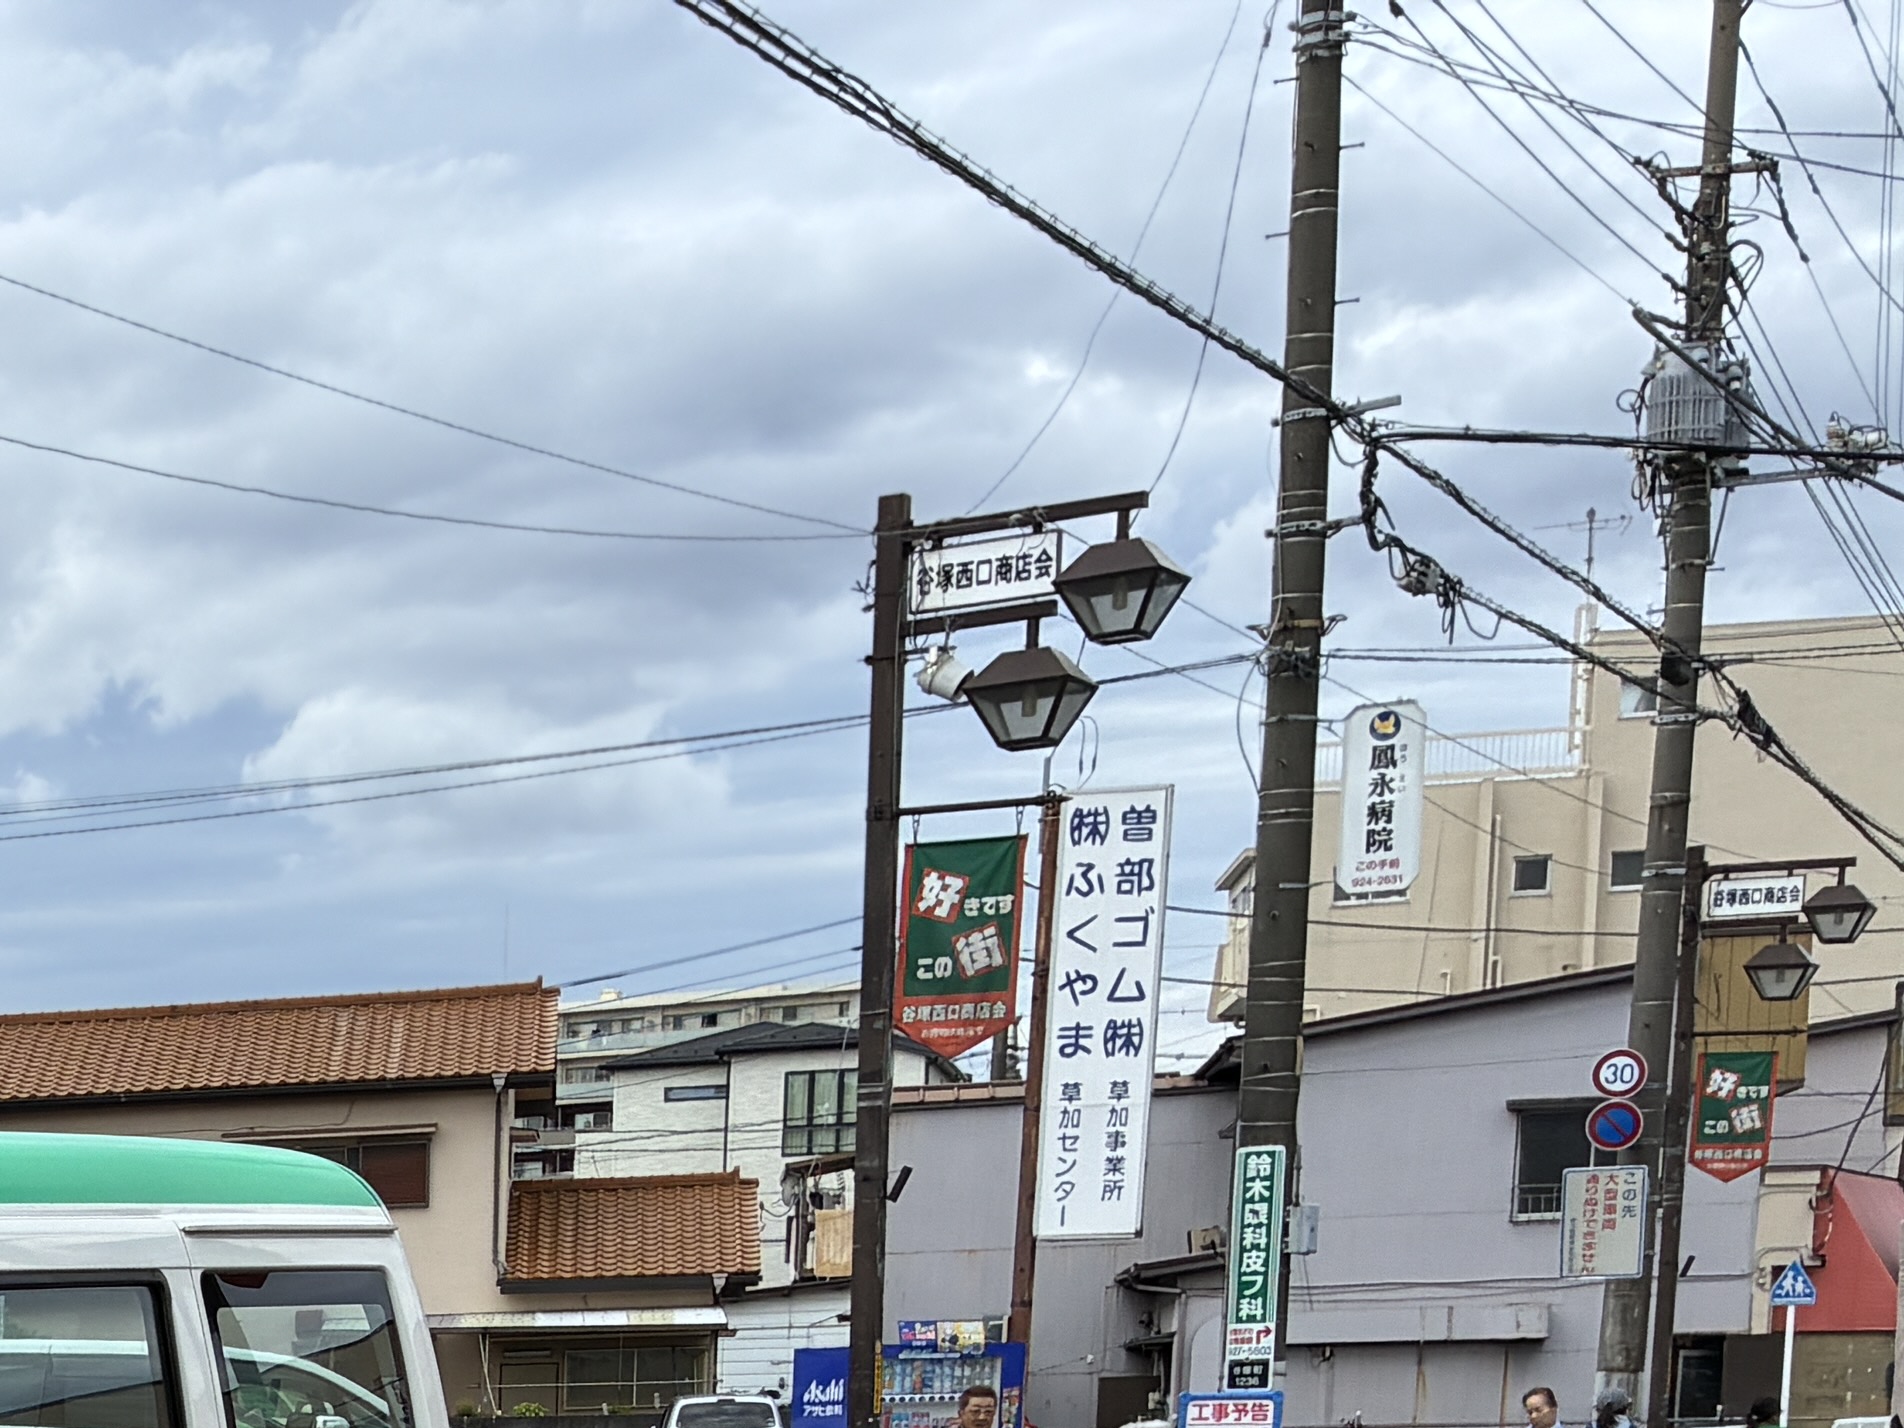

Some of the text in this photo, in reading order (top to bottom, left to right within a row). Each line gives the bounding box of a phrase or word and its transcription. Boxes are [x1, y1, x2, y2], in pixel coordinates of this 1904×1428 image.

[916, 546, 1054, 597] 谷塚西口商店会
[1604, 1063, 1635, 1085] 30
[1053, 1081, 1084, 1228] 草加センター
[1100, 1079, 1132, 1203] 草加事業所
[1621, 1171, 1638, 1219] この先
[1237, 1152, 1273, 1322] 鈴木眼科皮フ科
[802, 1378, 844, 1404] Asahi
[1190, 1402, 1271, 1423] 工事予告
